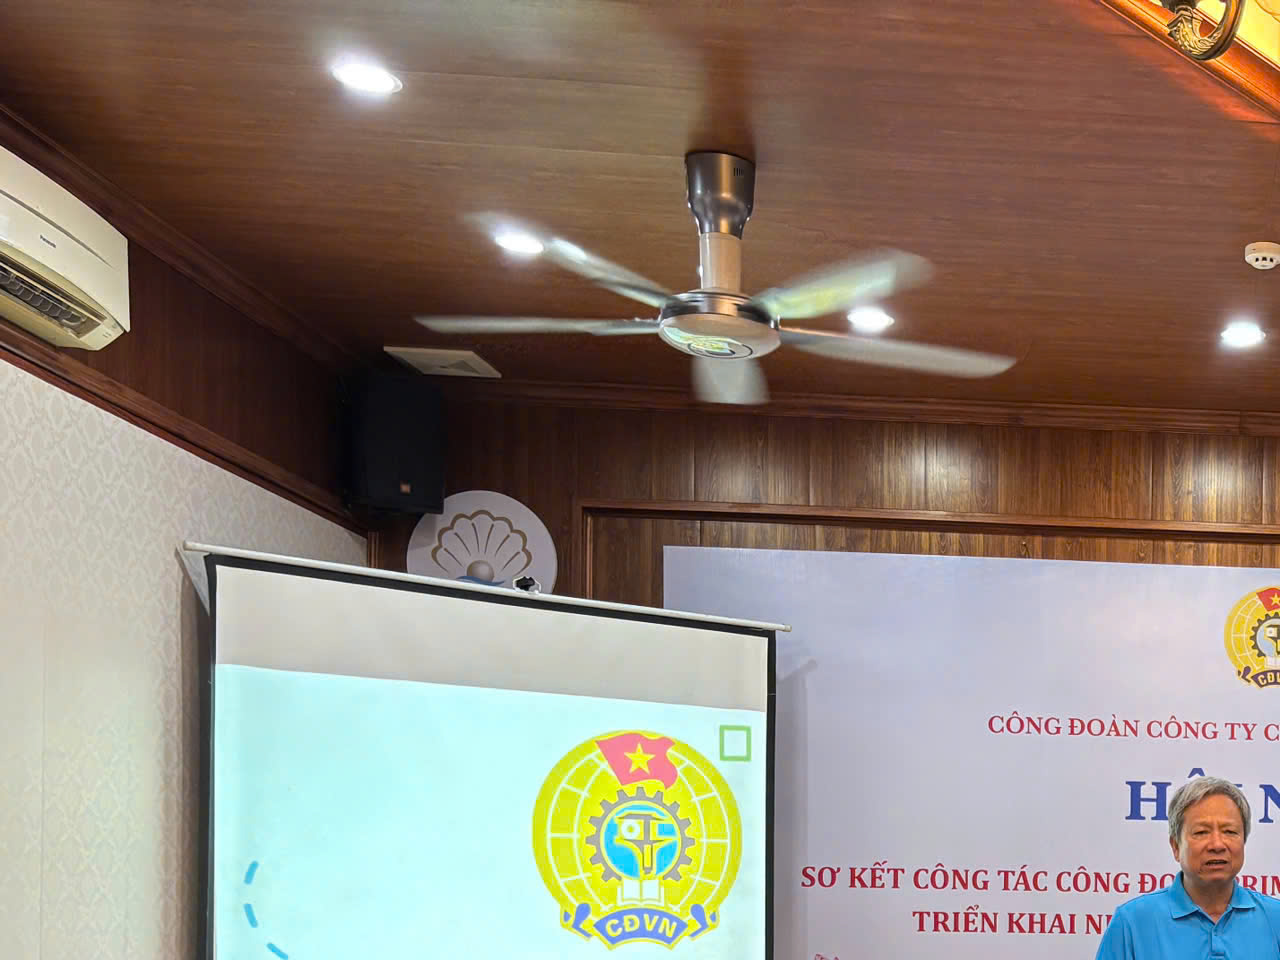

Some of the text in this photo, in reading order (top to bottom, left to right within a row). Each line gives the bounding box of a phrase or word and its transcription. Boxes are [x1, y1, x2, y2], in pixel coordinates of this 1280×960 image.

[987, 711, 1062, 736] CÔNG
[1068, 714, 1140, 738] ĐOÀN
[1146, 715, 1219, 740] CÔNG
[1224, 722, 1257, 741] TY
[800, 866, 841, 889] SƠ
[849, 860, 906, 889] KẾT
[912, 863, 990, 891] CÔNG
[996, 865, 1049, 892] TÁC
[1055, 866, 1130, 894] CÔNG
[1138, 873, 1175, 894] ĐO
[912, 905, 999, 934] TRIỂN
[1007, 912, 1077, 935] KHAI
